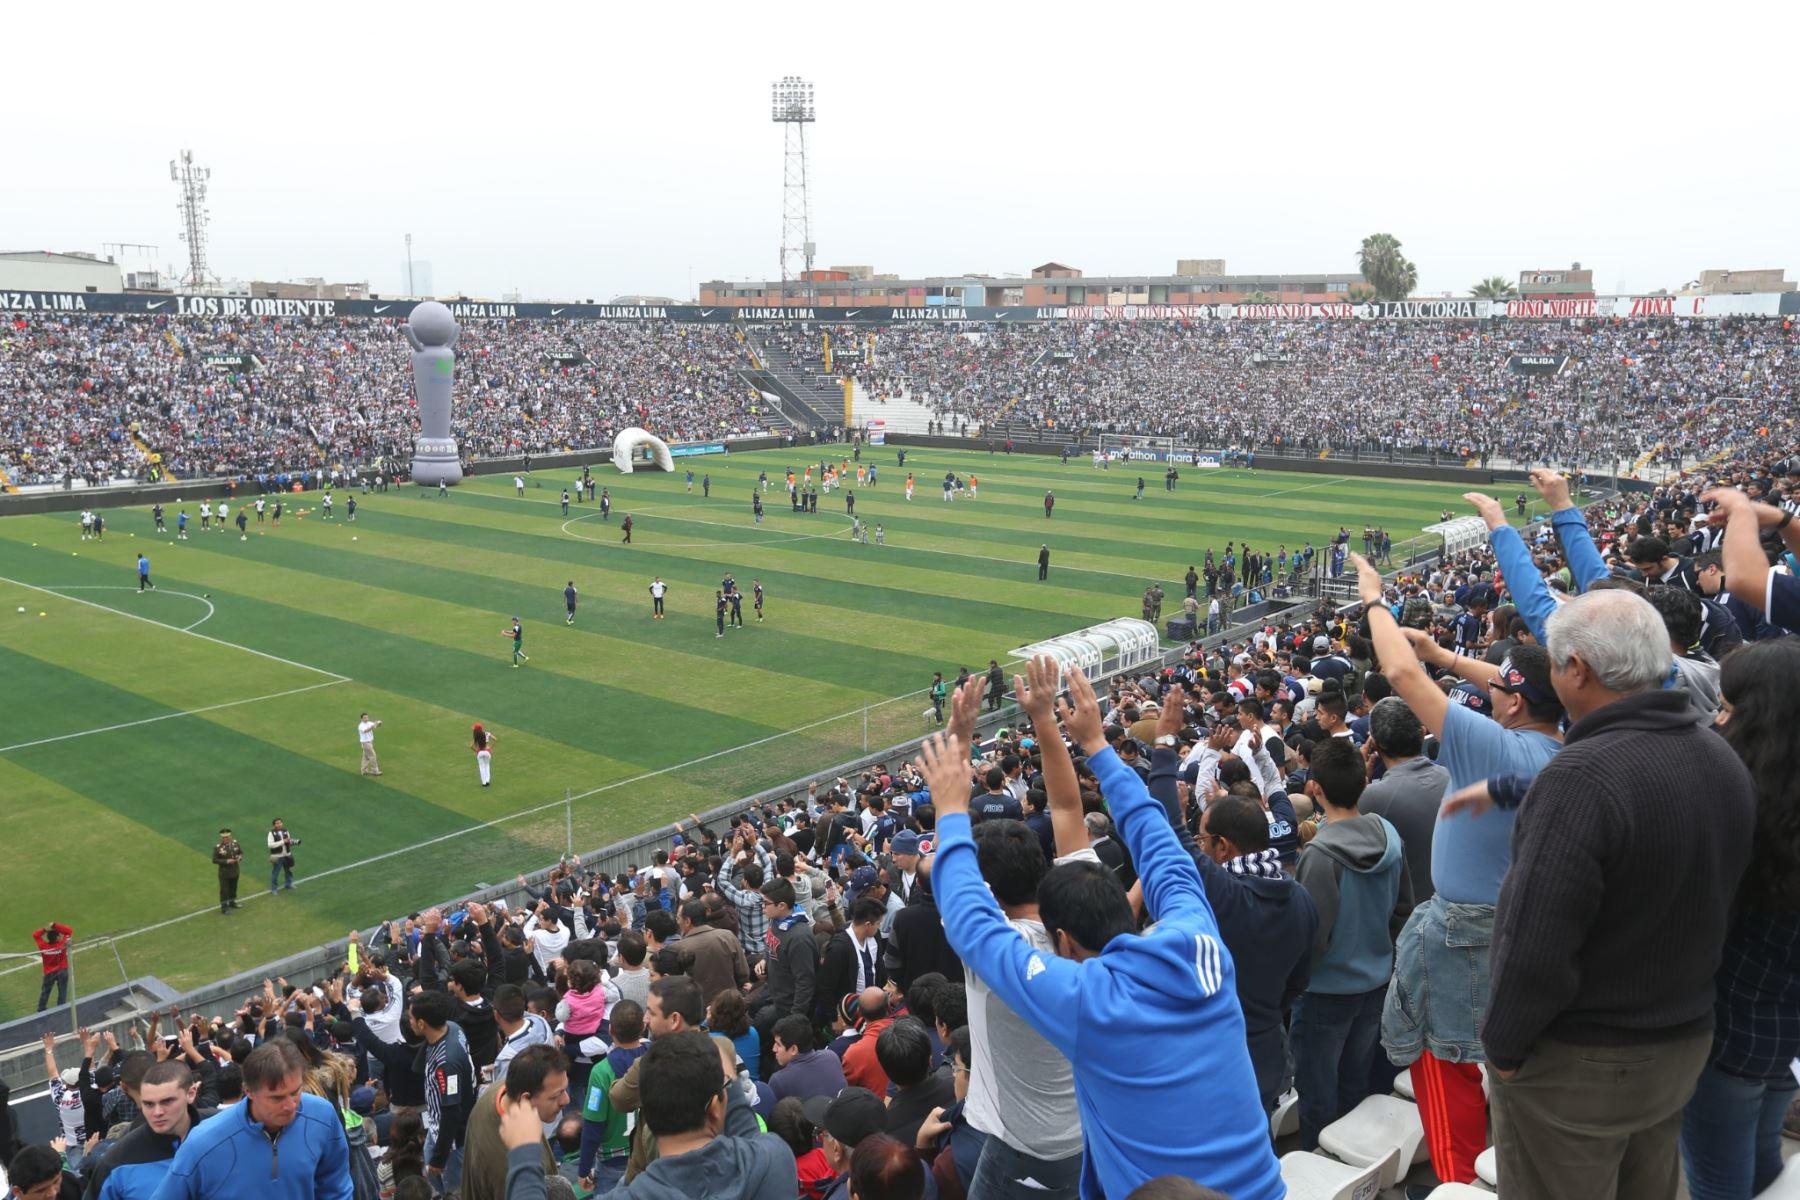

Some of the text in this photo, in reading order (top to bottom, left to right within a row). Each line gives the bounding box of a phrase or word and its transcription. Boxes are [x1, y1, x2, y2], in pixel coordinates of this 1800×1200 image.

[0, 293, 87, 310] NZA LIMA
[176, 296, 335, 317] LOS DE ORIENTE
[1631, 297, 1706, 315] ZONA C
[450, 304, 517, 318] IANZA LIMA
[600, 306, 667, 319] ALIANZA LIMA
[738, 308, 815, 319] ALIANZA LIMA
[892, 308, 968, 319] ALIANZA LIMA
[1170, 305, 1197, 320] ESTE
[1237, 303, 1313, 320] COMANDO
[1507, 300, 1597, 318] CONO NORTE
[1522, 357, 1555, 365] SALIDA
[1110, 449, 1157, 461] maathon
[1166, 453, 1215, 464] marahon
[1269, 820, 1292, 838] OC
